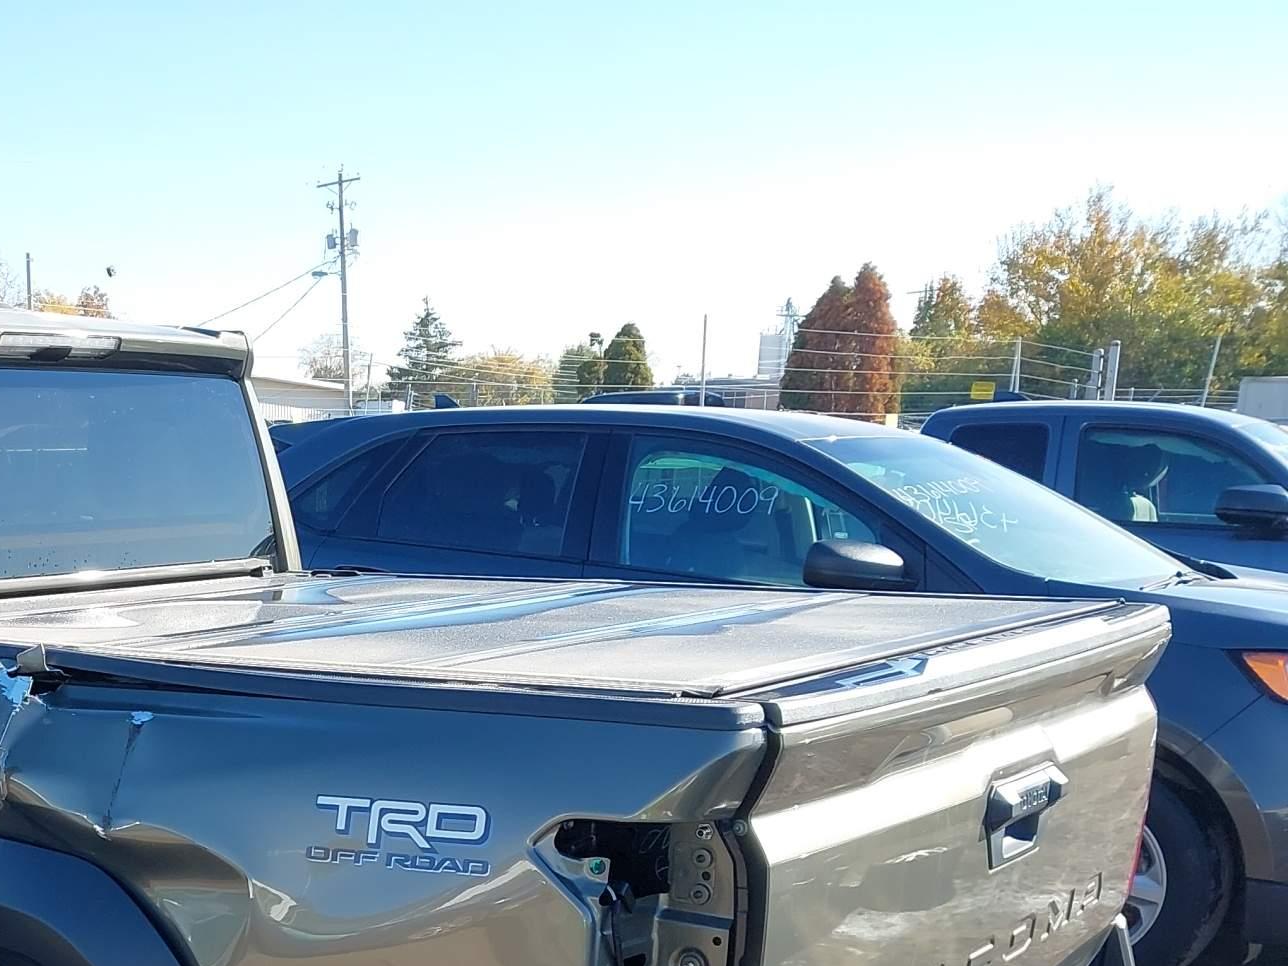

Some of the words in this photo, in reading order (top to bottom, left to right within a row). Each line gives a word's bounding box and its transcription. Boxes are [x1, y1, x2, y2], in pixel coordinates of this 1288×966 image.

[629, 482, 779, 515] 43614009
[316, 795, 492, 852] TRD
[305, 846, 380, 866] OFF
[385, 852, 491, 877] ROAD
